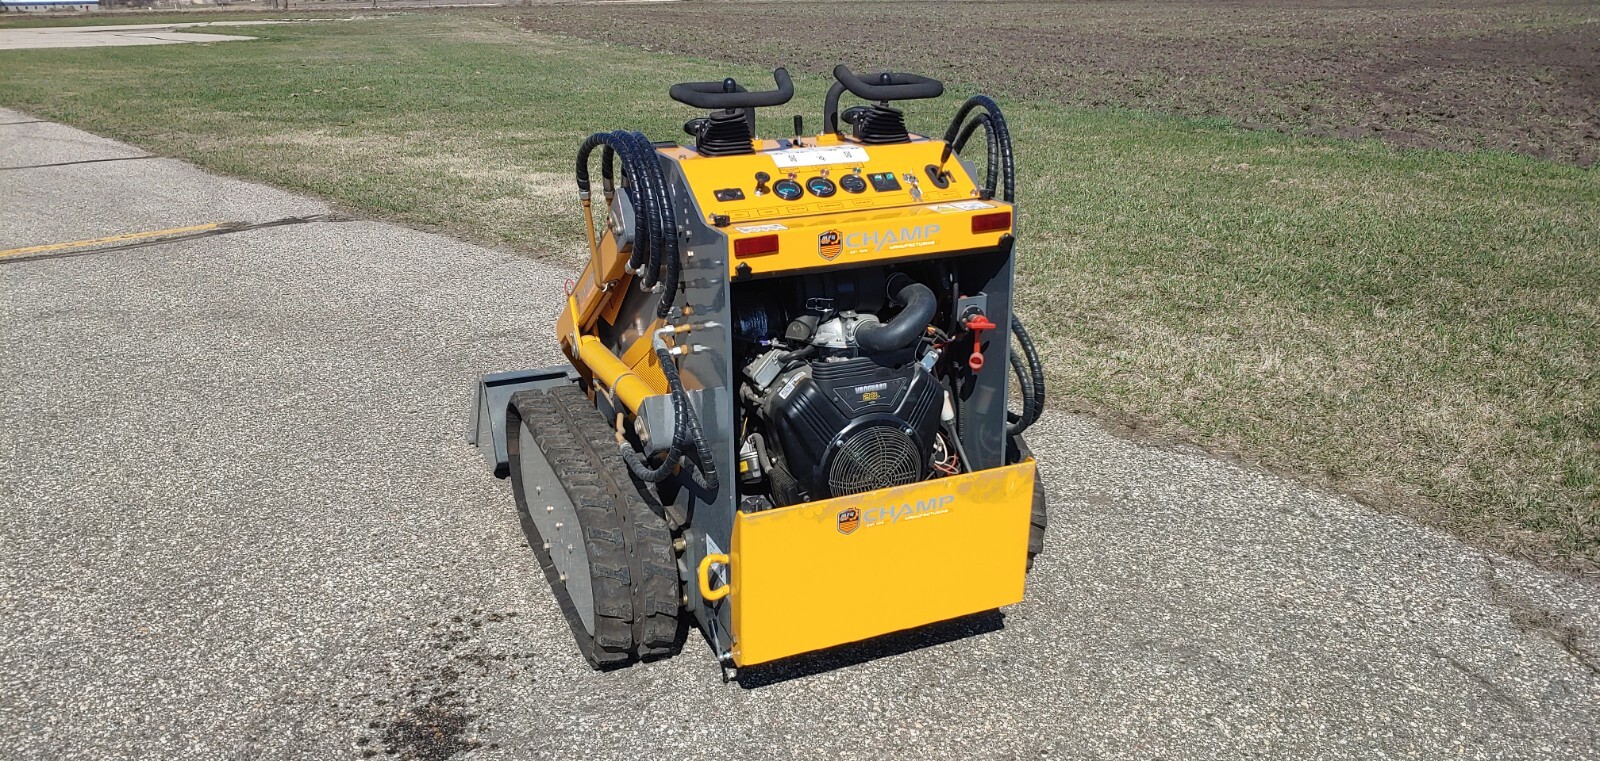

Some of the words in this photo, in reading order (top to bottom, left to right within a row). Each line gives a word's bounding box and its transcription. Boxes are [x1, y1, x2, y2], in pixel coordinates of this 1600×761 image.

[845, 224, 940, 252] CHAMP
[889, 240, 936, 250] MANUFACTURING
[863, 495, 955, 523] CHAMP
